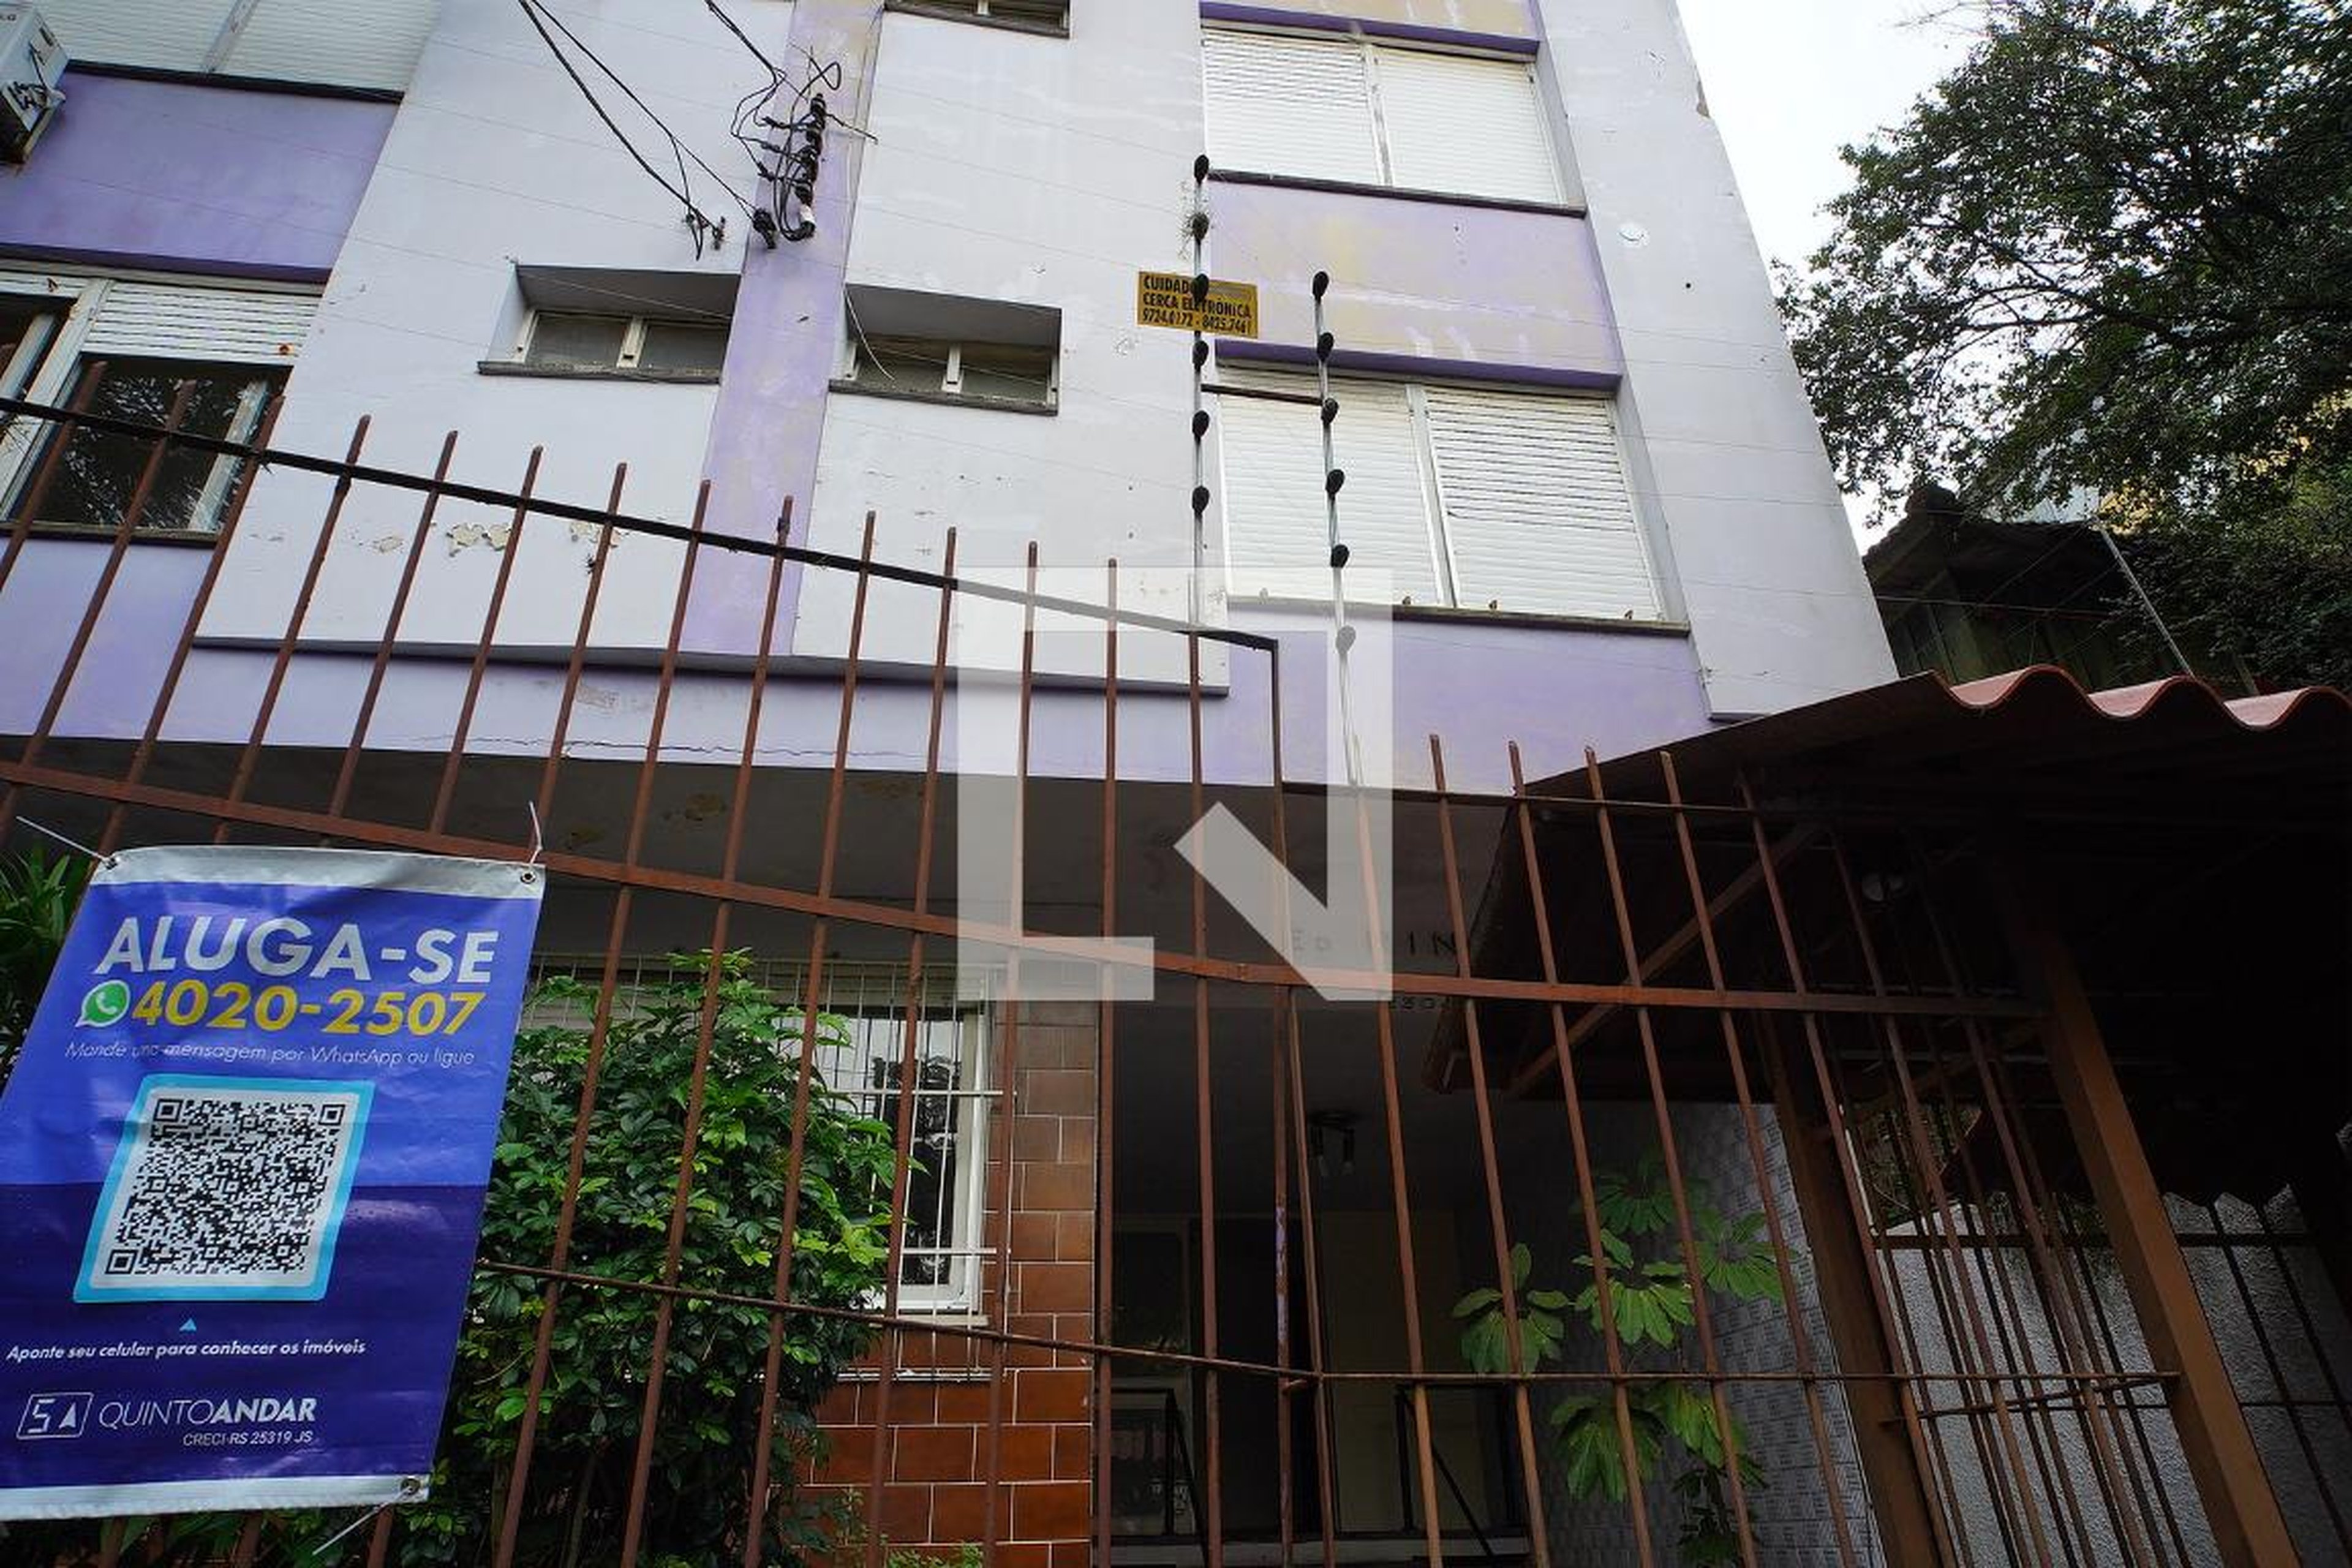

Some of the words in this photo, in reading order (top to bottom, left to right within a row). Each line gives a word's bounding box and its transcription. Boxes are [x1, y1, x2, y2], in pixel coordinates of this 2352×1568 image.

[1144, 275, 1197, 294] CUIDAD
[1143, 292, 1178, 309] CERCA
[93, 916, 499, 985] ALUGA-SE
[132, 979, 487, 1036] 4020-2507
[64, 1041, 127, 1058] Mande
[162, 1043, 267, 1063] mensagem
[270, 1046, 305, 1064] por
[310, 1045, 402, 1068] WhatsApp
[407, 1052, 429, 1065] ou
[434, 1047, 475, 1068] ligue
[6, 1345, 64, 1363] Aponte
[67, 1347, 96, 1359] seu
[99, 1341, 154, 1357] celular
[155, 1344, 196, 1360] para
[200, 1340, 277, 1355] conhecer
[280, 1343, 299, 1355] os
[303, 1338, 366, 1355] imóveis
[99, 1397, 317, 1430] QUINTOANDAR
[250, 1430, 293, 1445] 25319
[294, 1430, 314, 1443] JS
